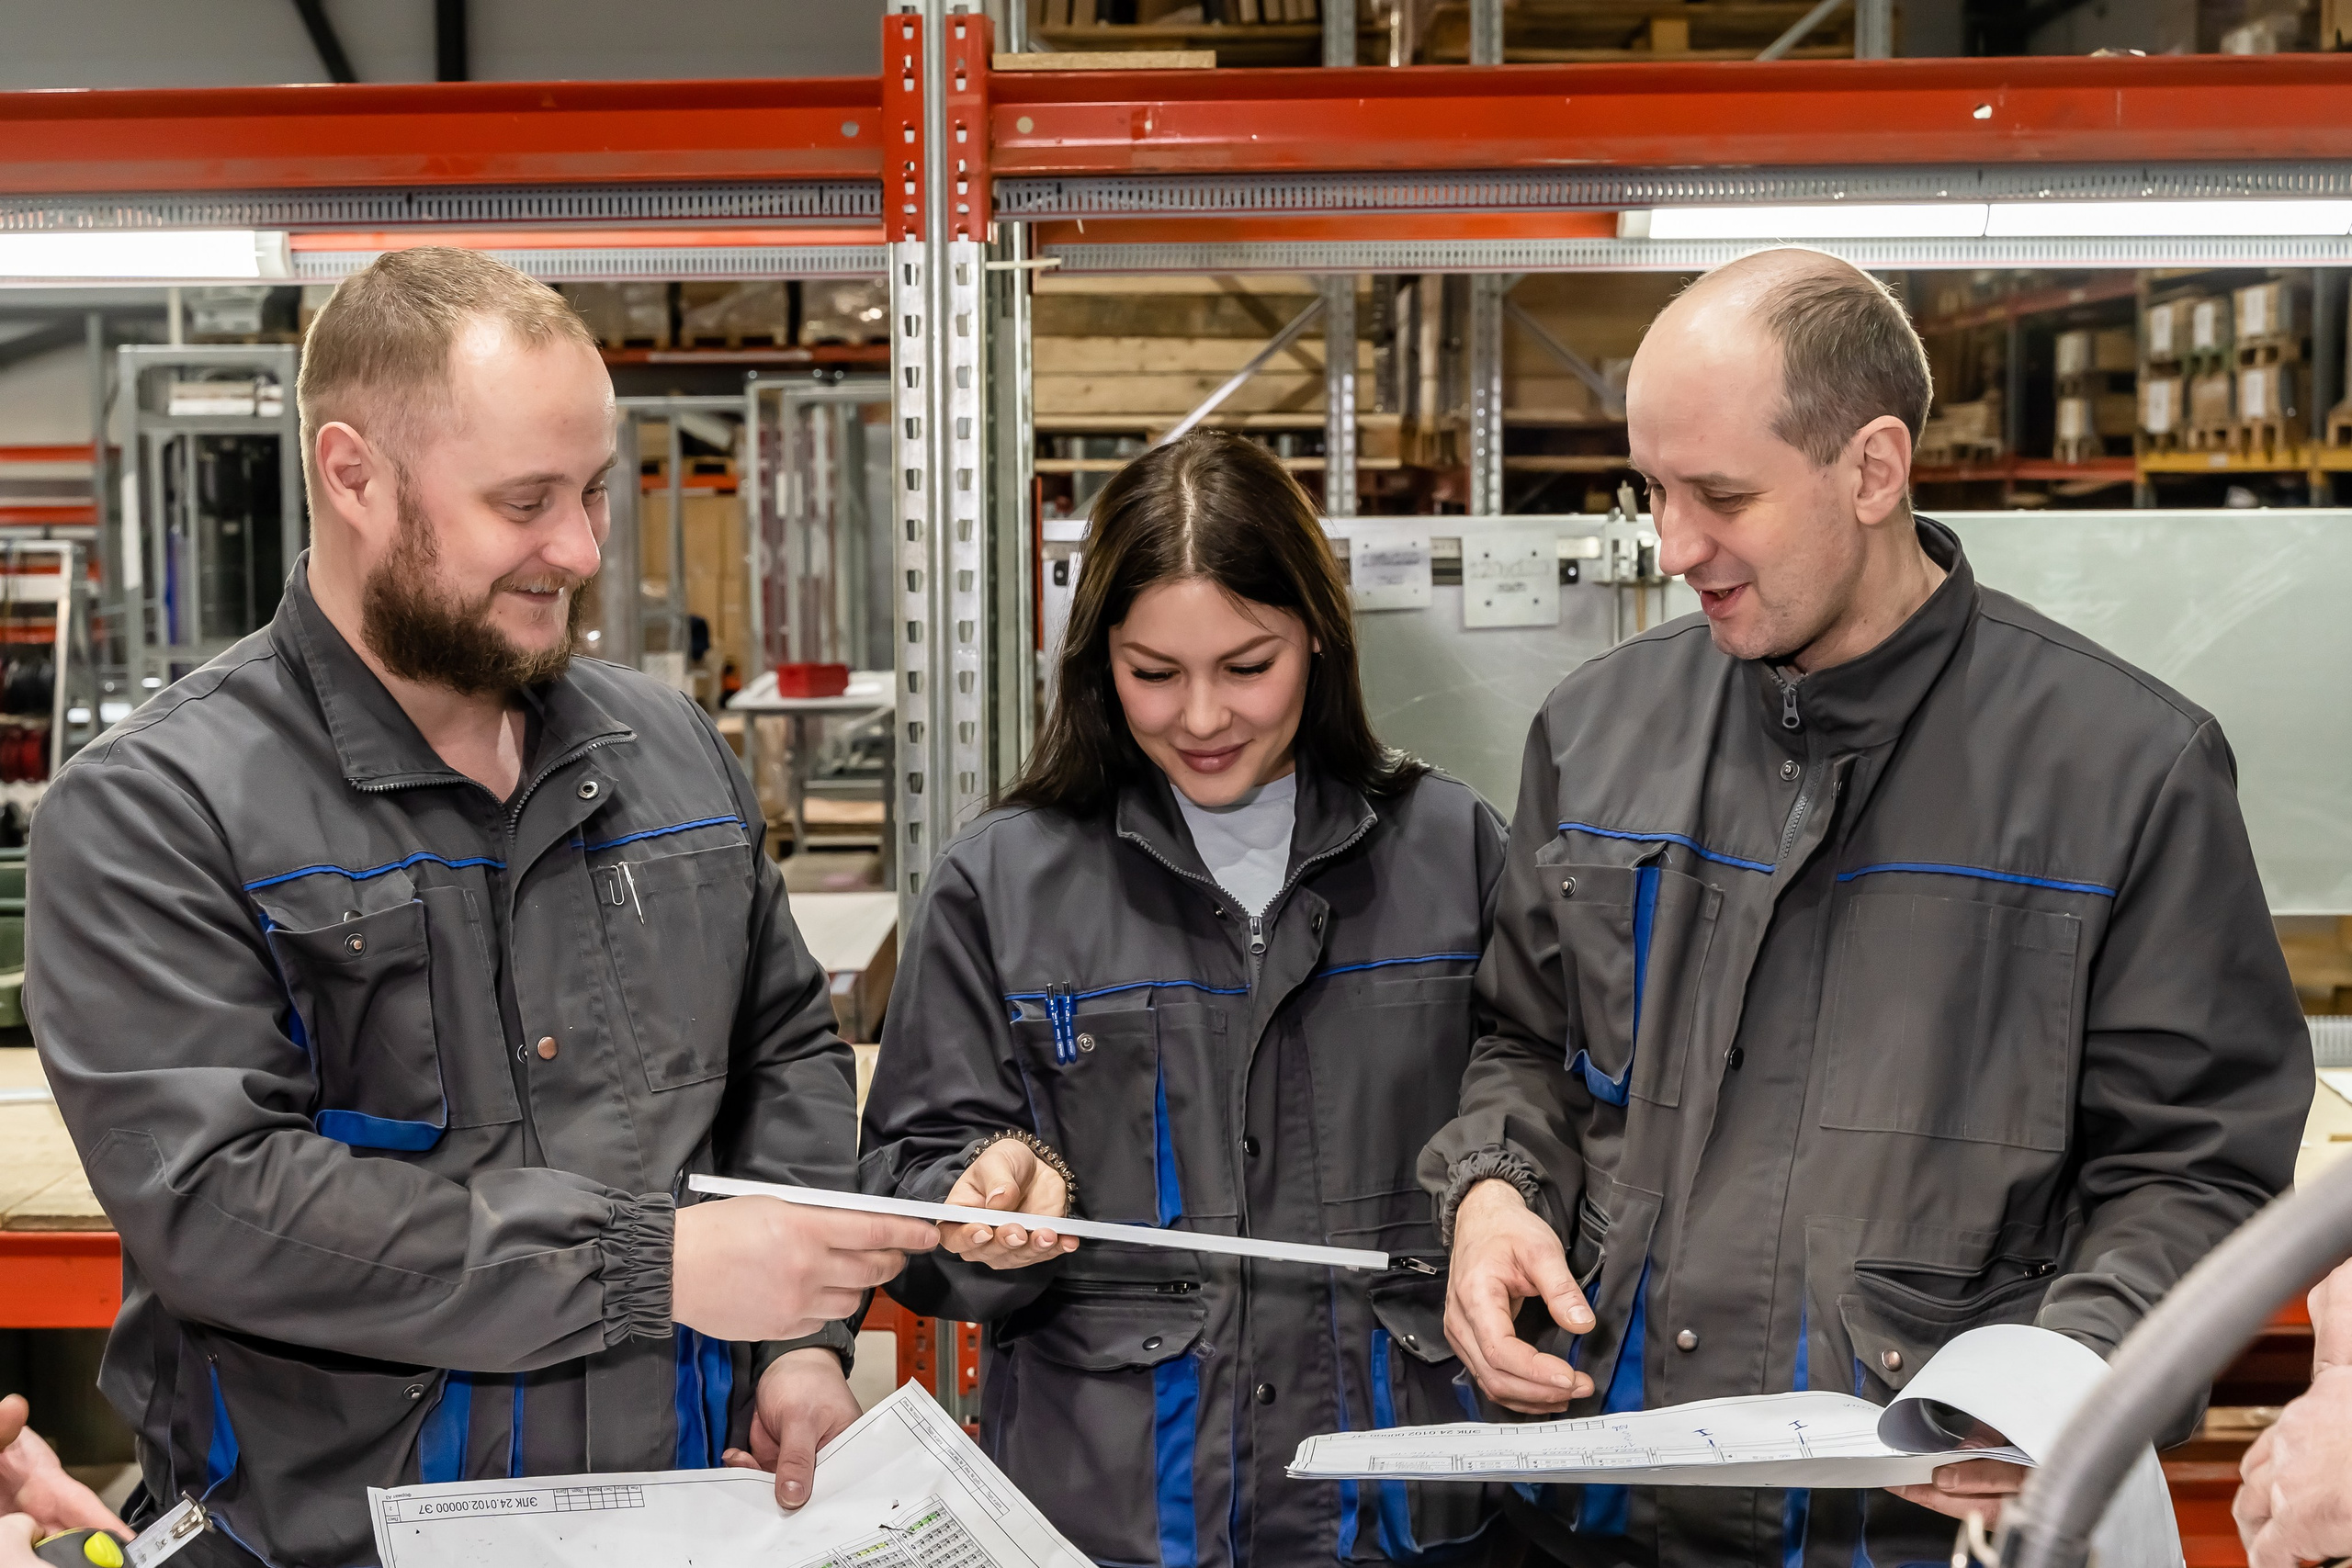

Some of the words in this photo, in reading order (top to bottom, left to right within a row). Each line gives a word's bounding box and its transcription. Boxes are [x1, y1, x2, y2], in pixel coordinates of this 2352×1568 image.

[435, 1497, 513, 1513] 24.0102.00000
[515, 1496, 538, 1508] ЭЛК
[418, 1504, 434, 1515] Э7
